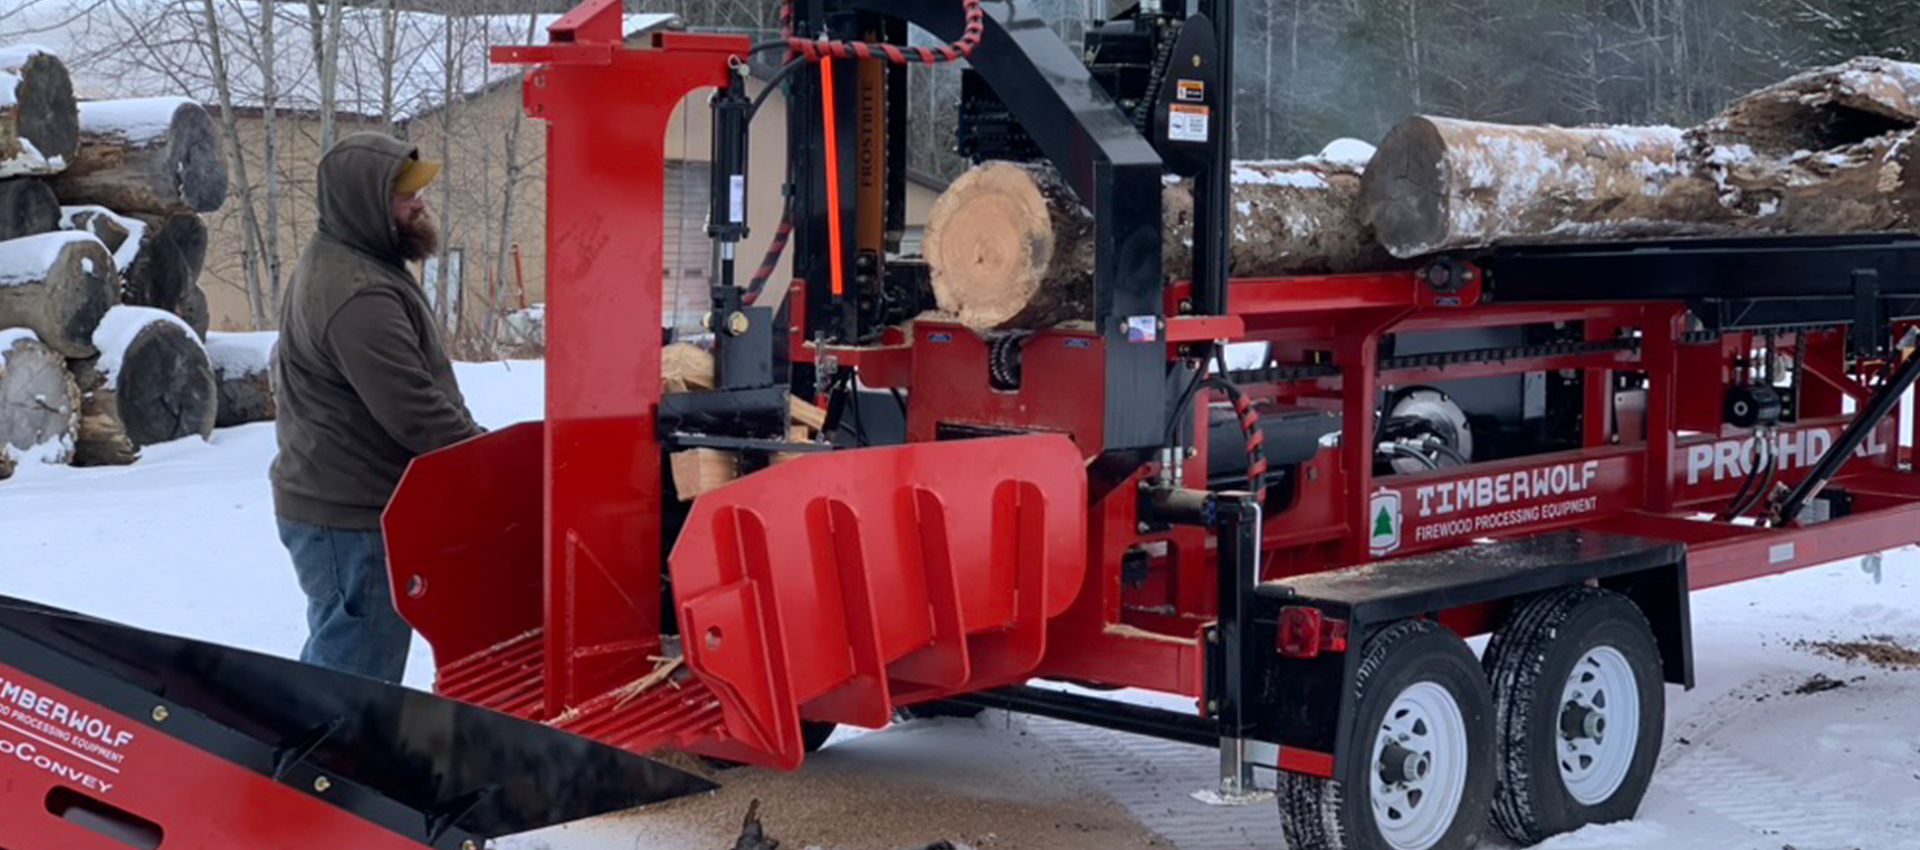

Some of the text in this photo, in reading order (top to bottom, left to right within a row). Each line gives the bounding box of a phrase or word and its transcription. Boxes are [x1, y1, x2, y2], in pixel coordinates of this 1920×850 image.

[860, 80, 873, 188] FROSTBITE
[1416, 460, 1598, 517] TIMBERWOLF
[1415, 496, 1598, 542] FIREWOOD PROCESSING EQUIPMENT
[10, 709, 71, 742] PROCESSING
[71, 735, 125, 764] EQUIPMENT
